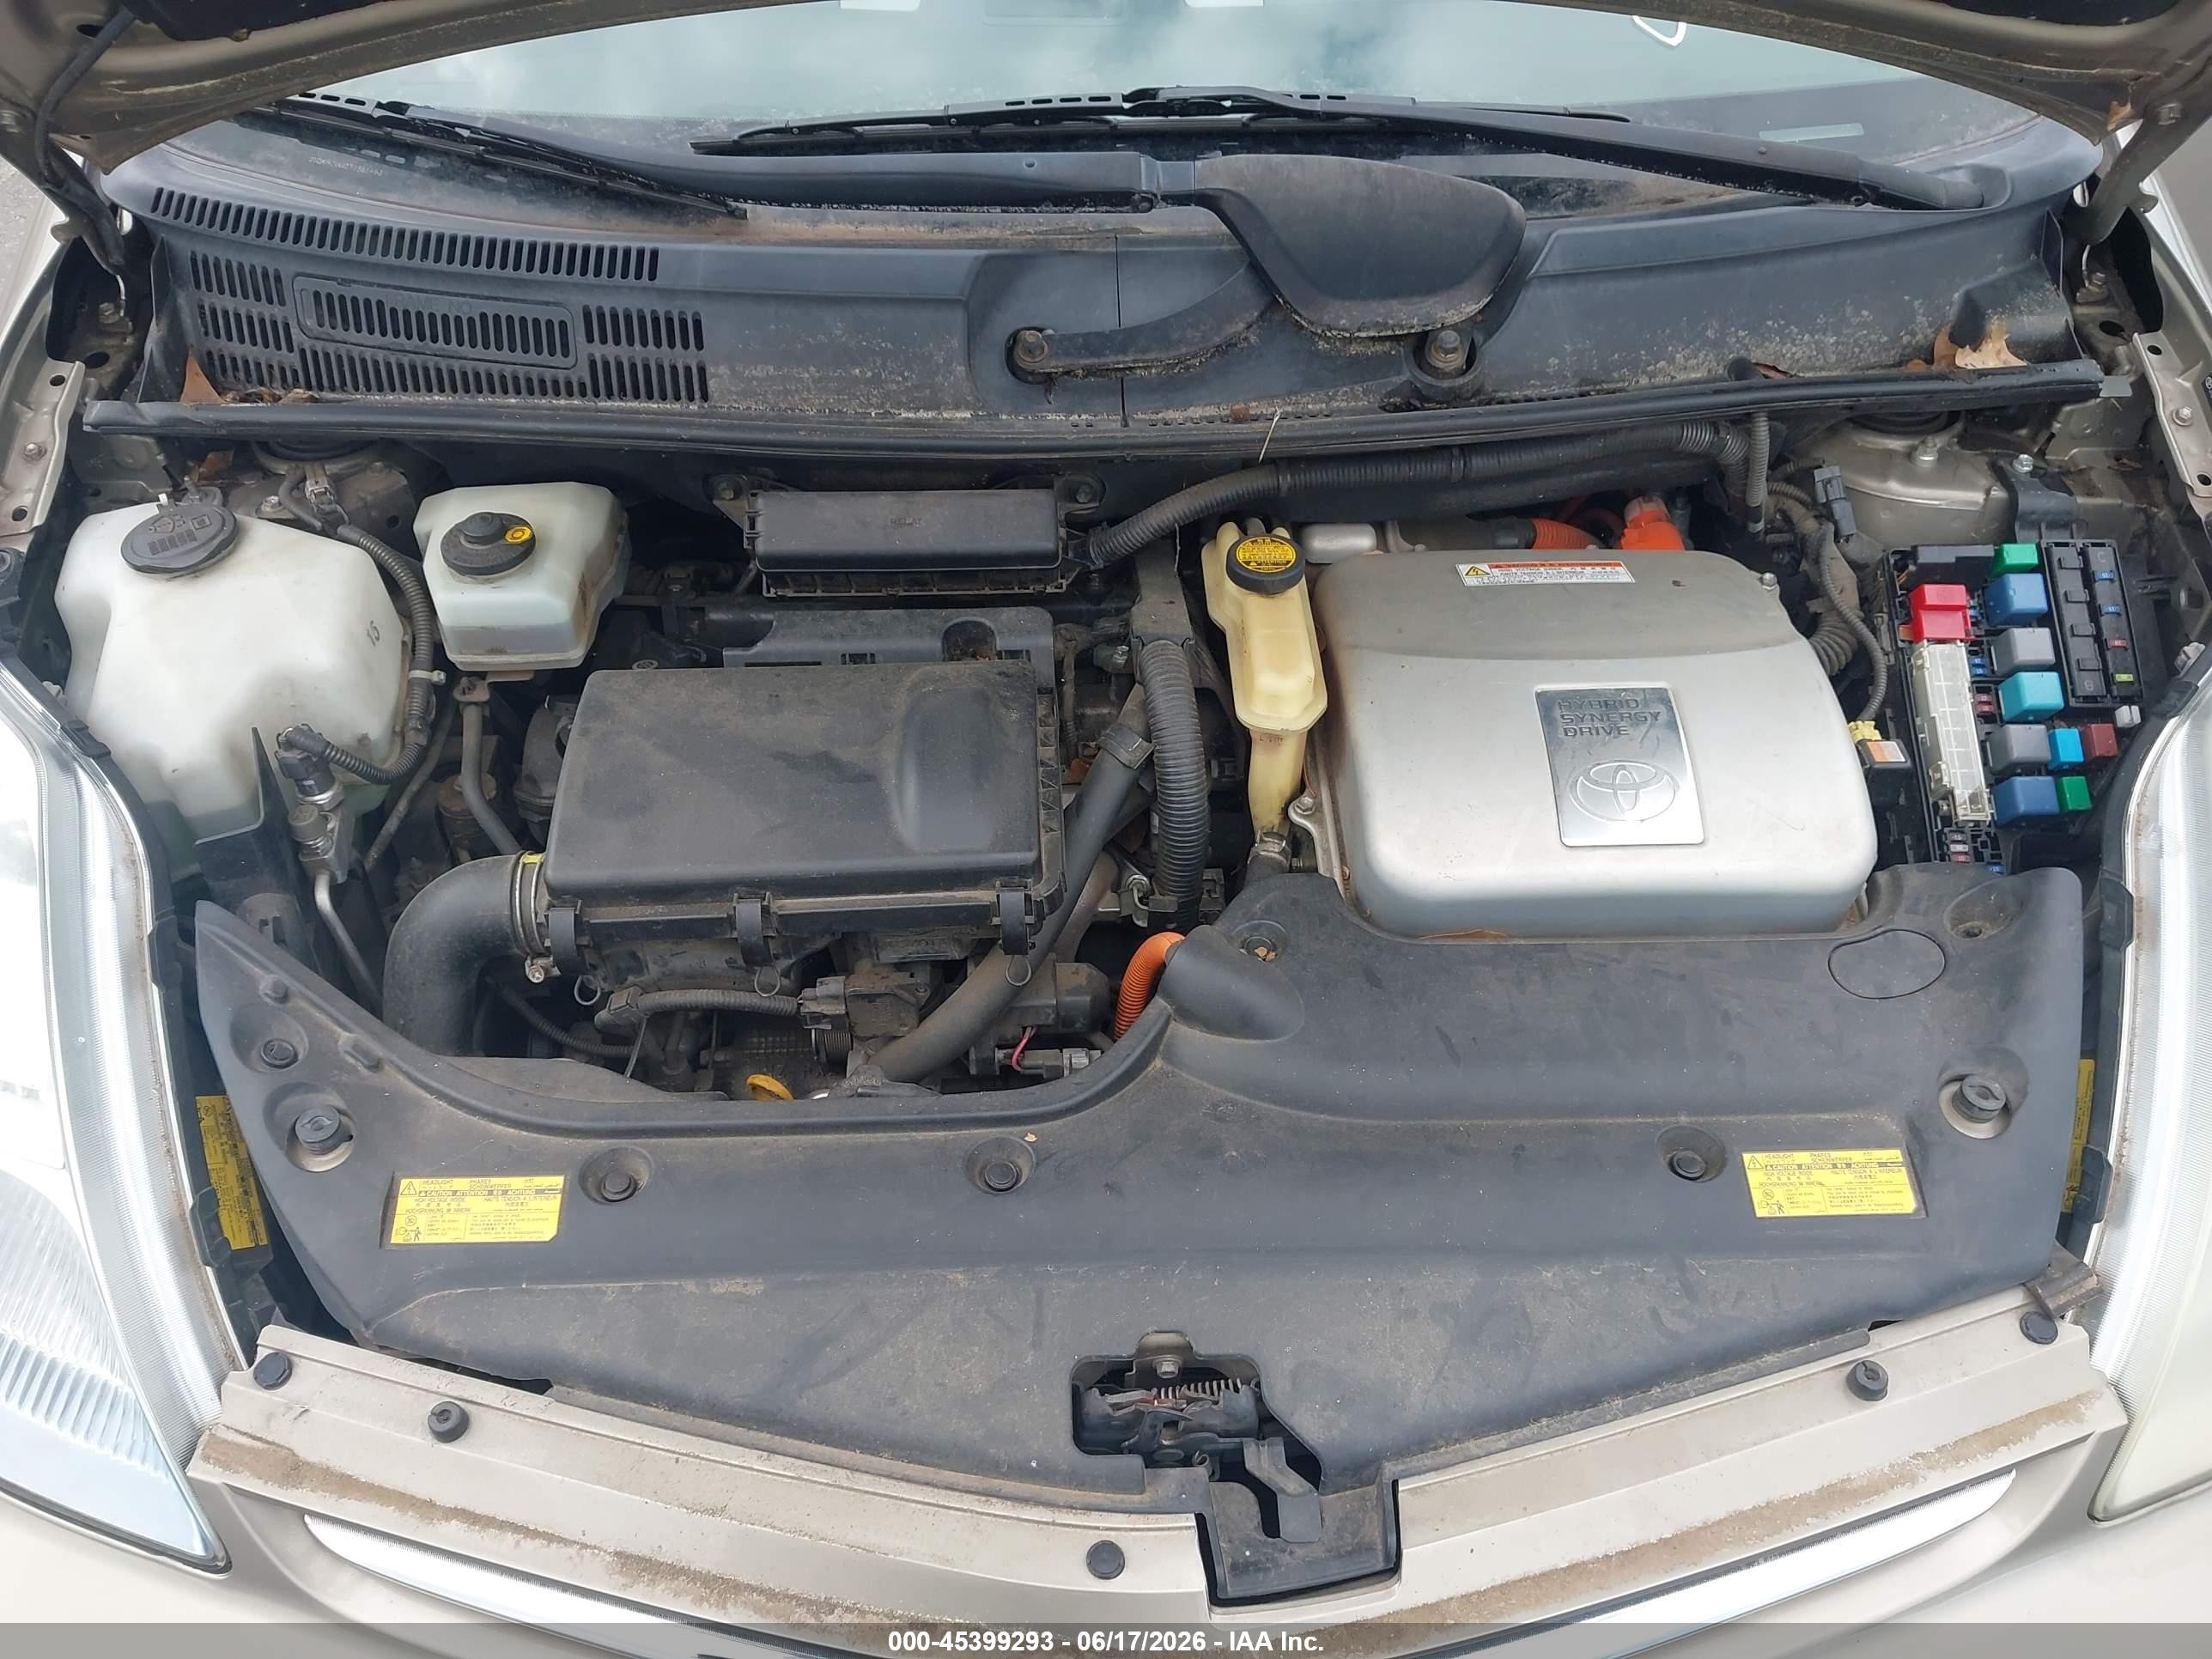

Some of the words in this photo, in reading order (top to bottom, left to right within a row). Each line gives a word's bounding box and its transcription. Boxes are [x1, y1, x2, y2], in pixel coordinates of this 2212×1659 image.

[1558, 698, 1640, 711] HYBRID
[1559, 711, 1662, 724] SYNERGY
[1562, 725, 1630, 737] DRIVE
